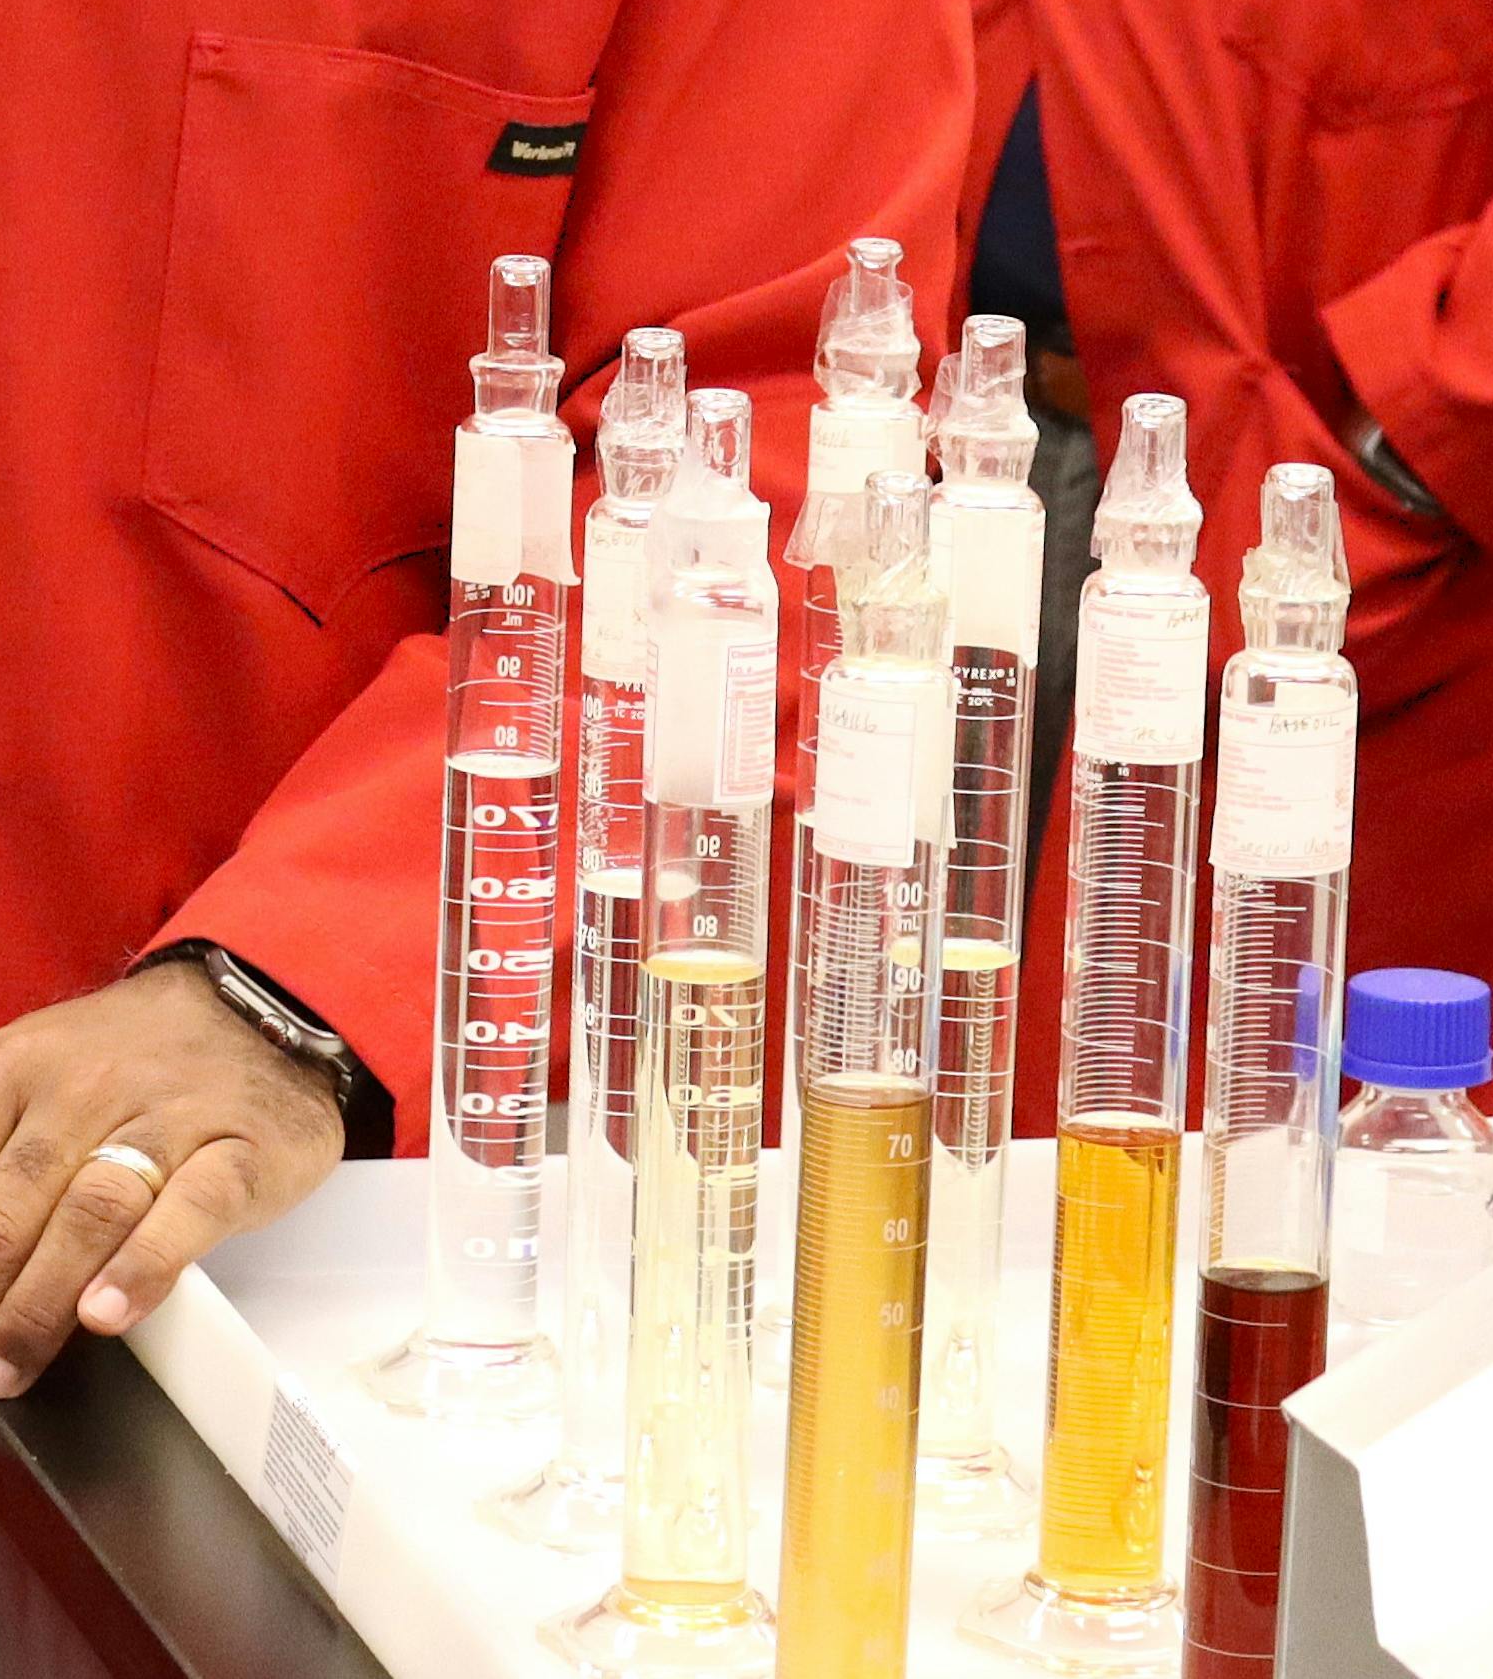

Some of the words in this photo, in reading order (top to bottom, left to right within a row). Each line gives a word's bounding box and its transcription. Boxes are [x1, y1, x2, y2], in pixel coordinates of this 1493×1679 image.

[883, 881, 925, 909] 100
[893, 966, 922, 992] 90
[891, 1049, 917, 1074] 80
[887, 1133, 914, 1160] 70
[882, 1218, 909, 1243] 60
[879, 1302, 905, 1328] 50
